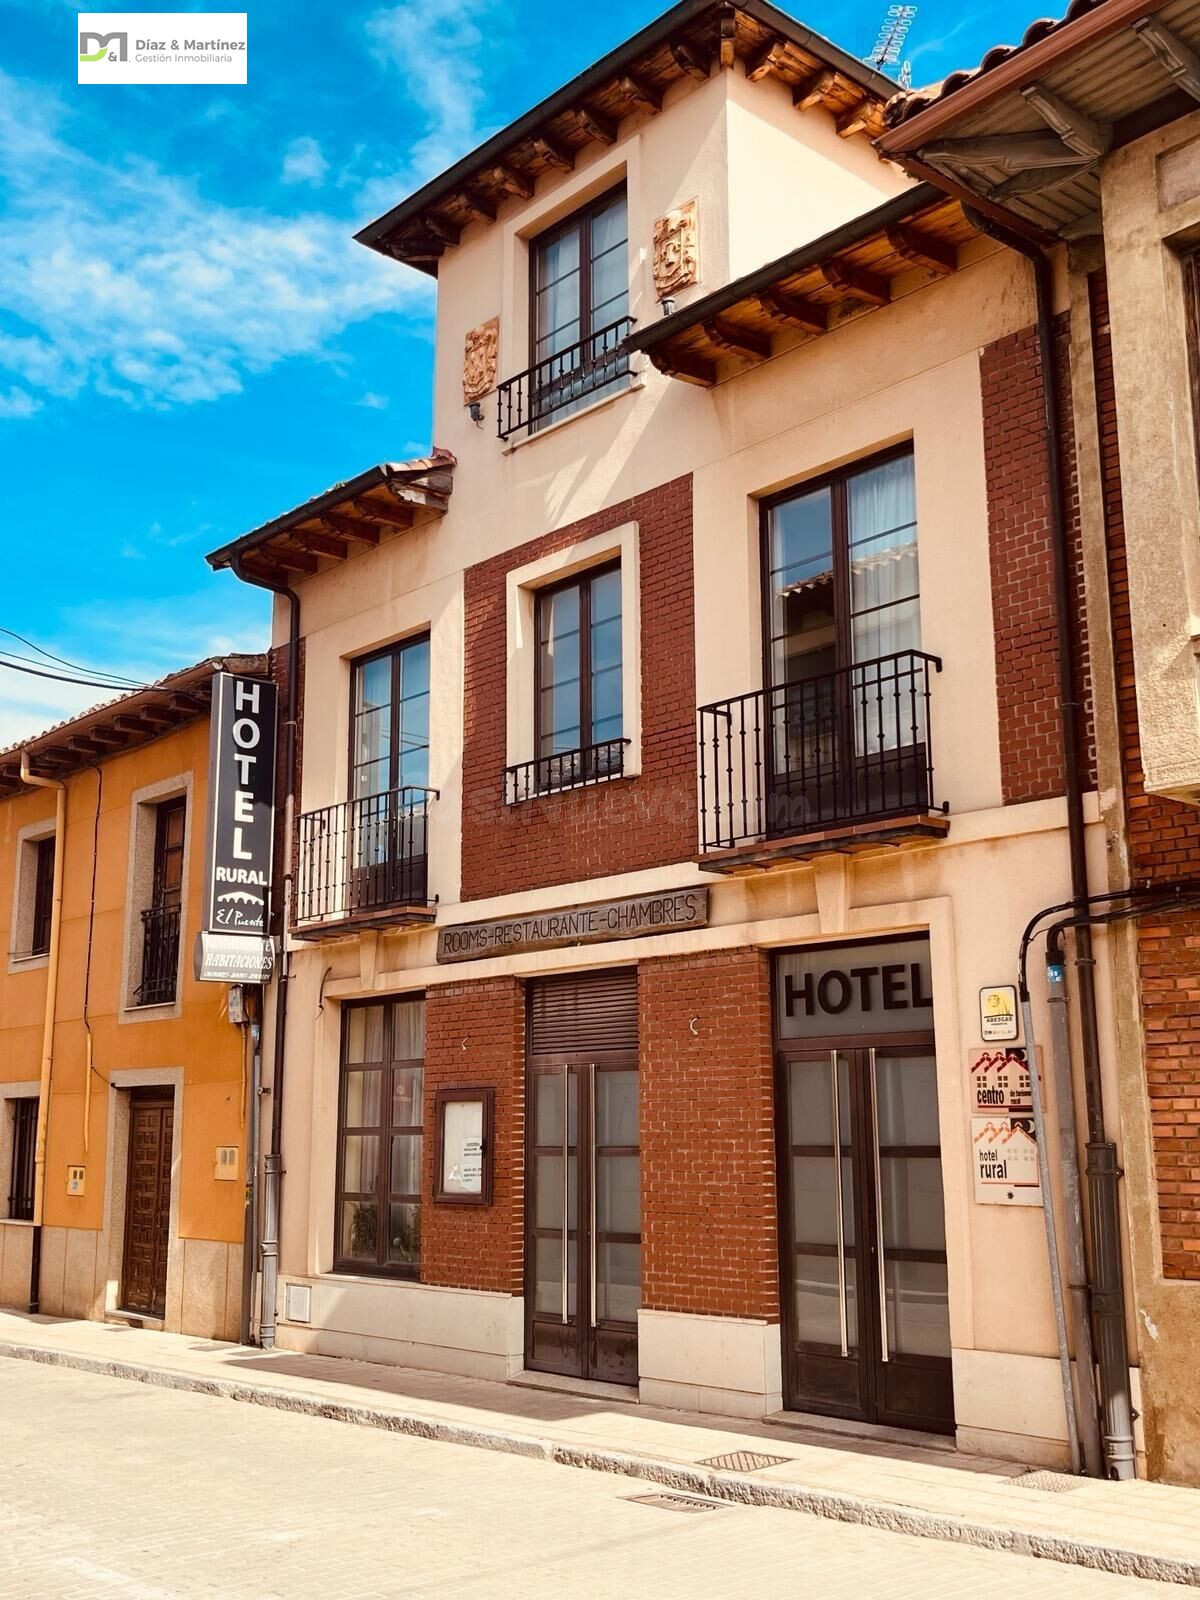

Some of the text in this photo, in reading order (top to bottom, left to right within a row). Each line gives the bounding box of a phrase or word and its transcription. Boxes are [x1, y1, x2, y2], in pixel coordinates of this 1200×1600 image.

[232, 681, 261, 861] HOTEL
[216, 867, 268, 886] RURAL
[216, 908, 264, 927] El Puente
[205, 953, 273, 970] HABITACIONES
[784, 963, 934, 1017] HOTEL
[977, 1085, 1005, 1105] centro
[979, 1149, 998, 1161] hotel
[980, 1160, 1008, 1179] rural
